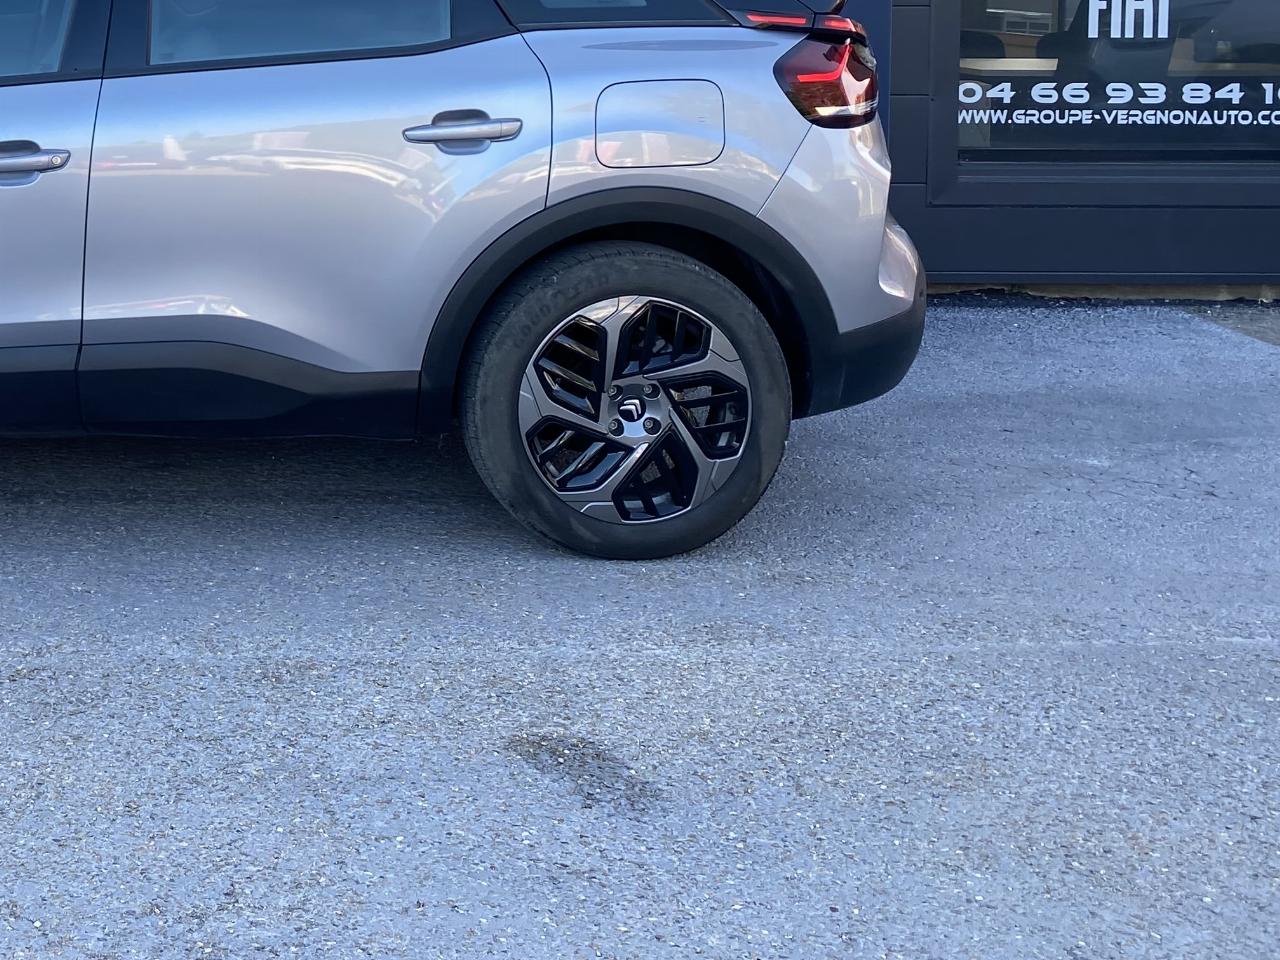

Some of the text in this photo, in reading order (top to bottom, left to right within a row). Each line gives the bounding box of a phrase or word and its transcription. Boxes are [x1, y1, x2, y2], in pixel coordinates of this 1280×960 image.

[958, 82, 1280, 104] 04 66 93 84 1
